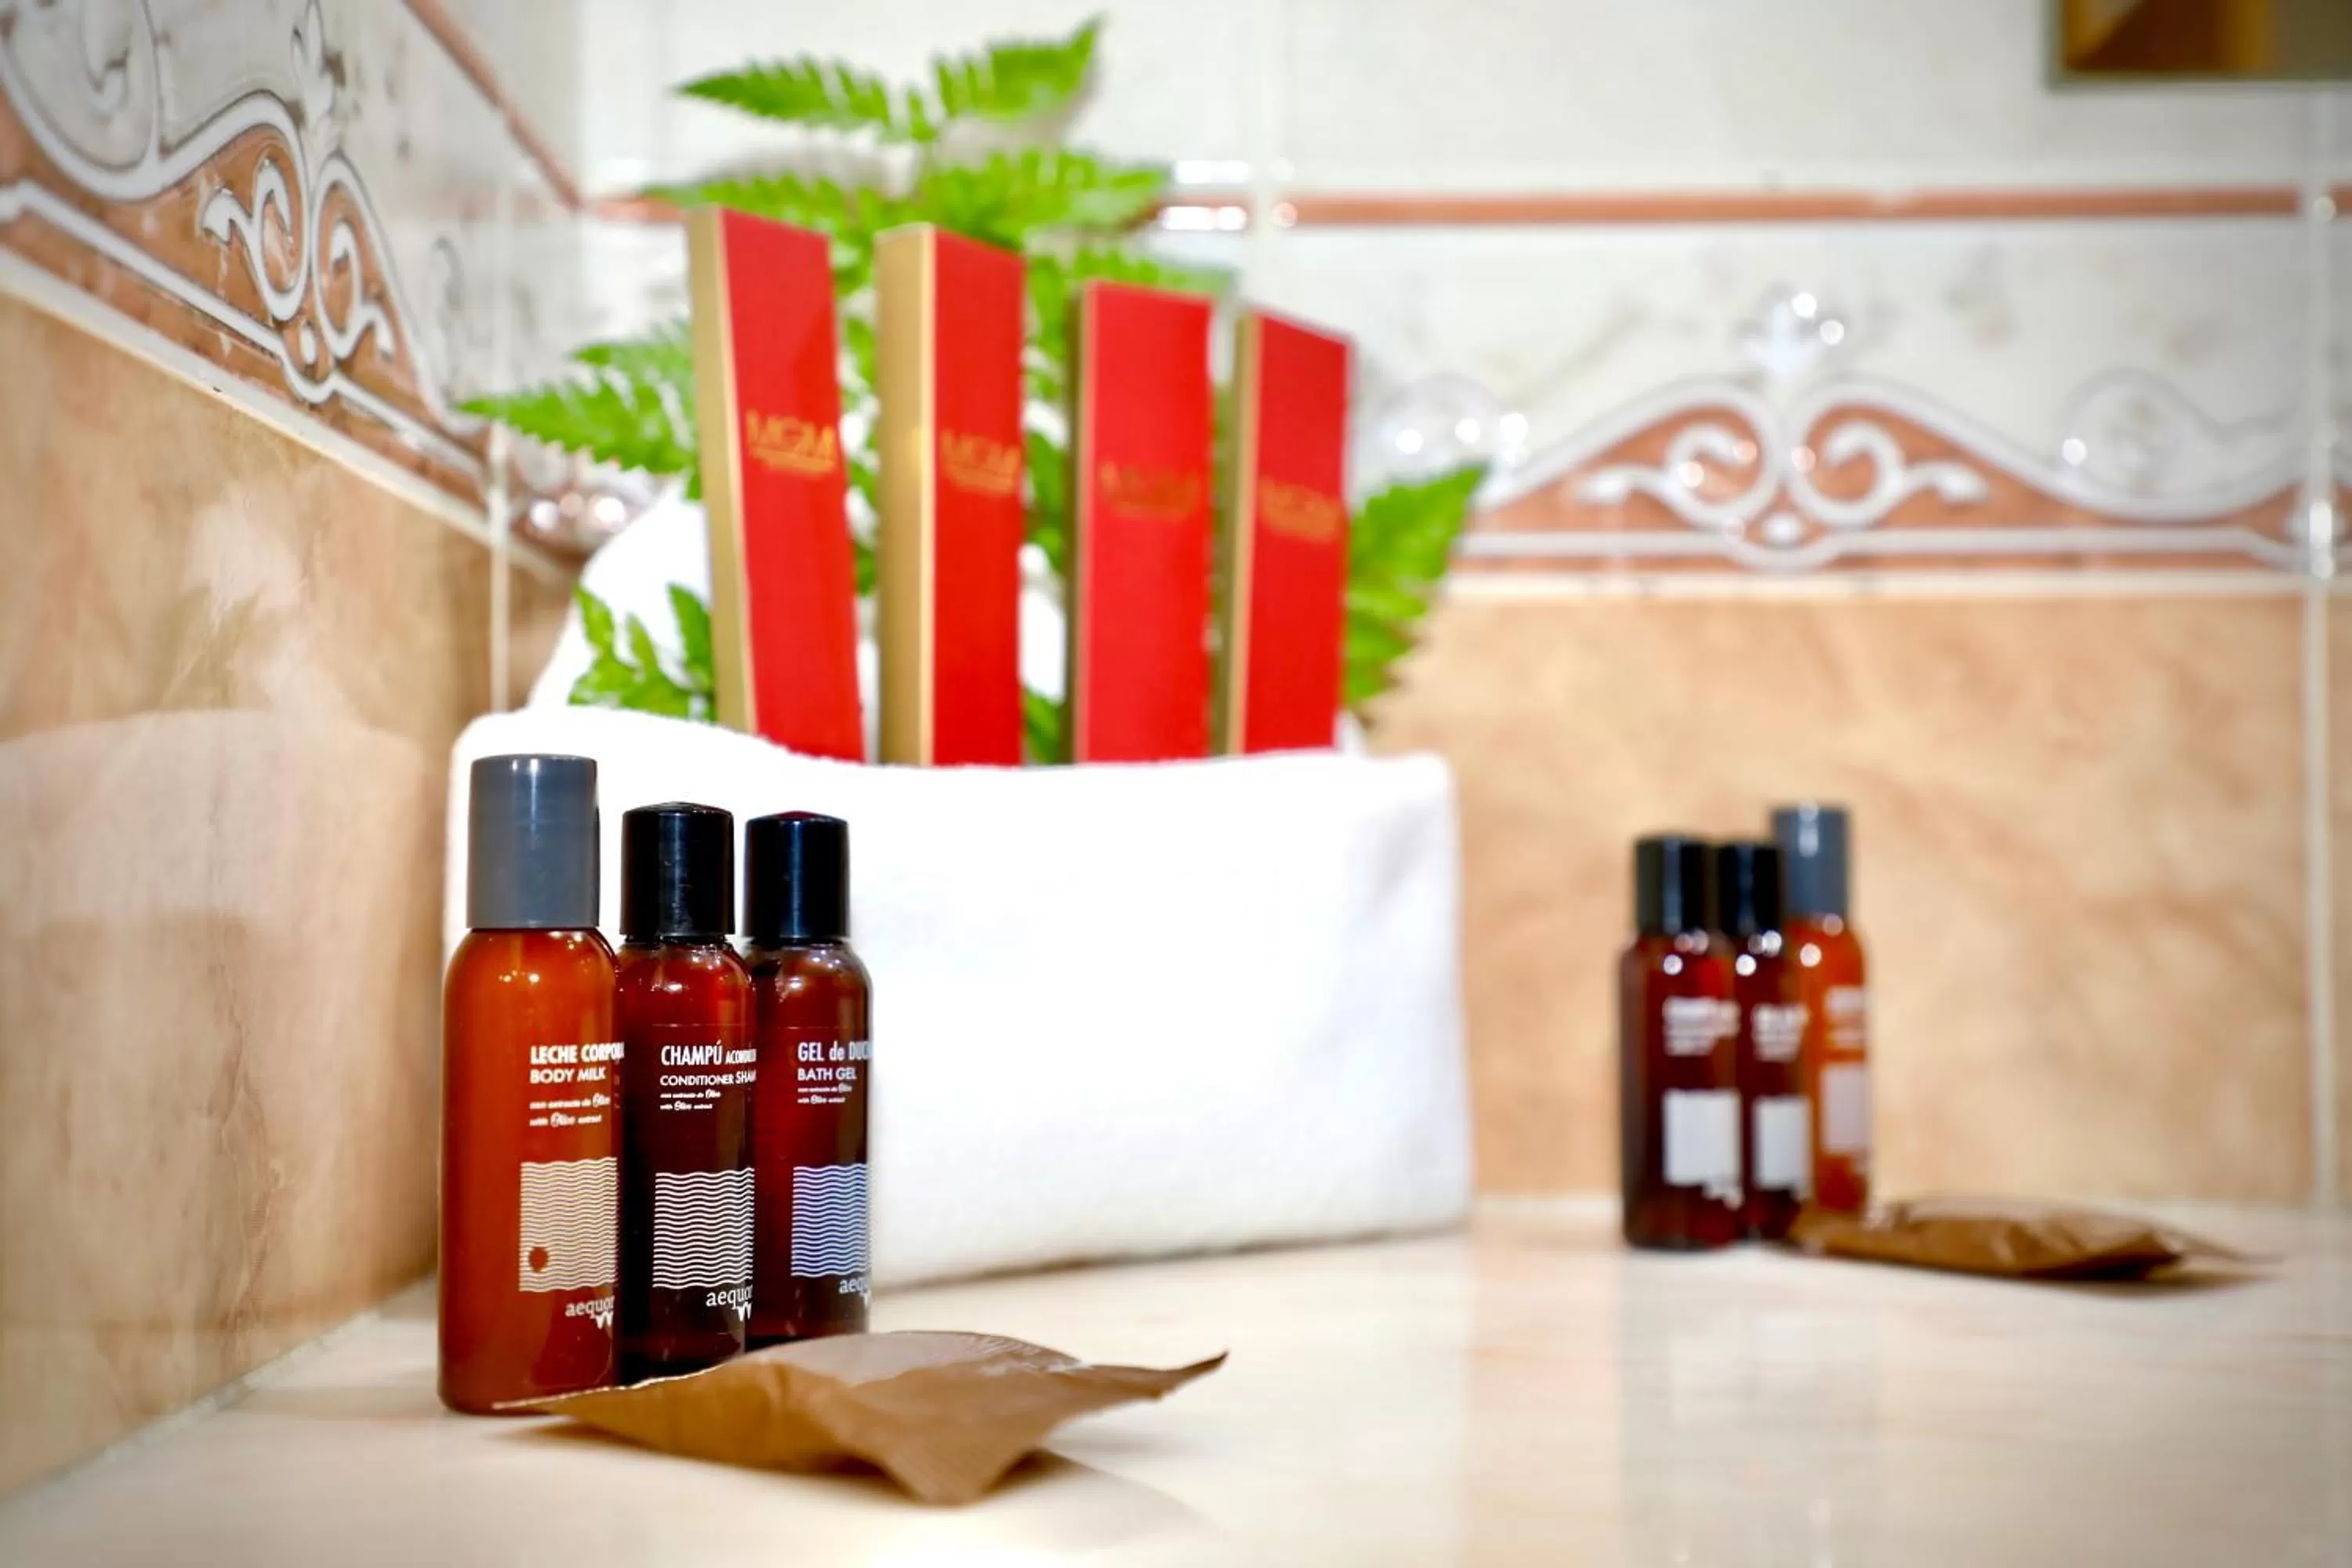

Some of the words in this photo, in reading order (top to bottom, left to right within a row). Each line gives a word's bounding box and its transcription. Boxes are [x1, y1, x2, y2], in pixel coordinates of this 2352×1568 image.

[530, 1044, 579, 1065] LECHE
[661, 1039, 722, 1065] CHAMPÚ
[797, 1041, 826, 1062] GEL
[829, 1040, 845, 1061] de
[529, 1068, 575, 1083] BODY
[576, 1065, 606, 1082] MILK
[659, 1073, 735, 1086] CONDITIONER
[797, 1067, 833, 1081] BATH
[835, 1066, 857, 1080] GEL
